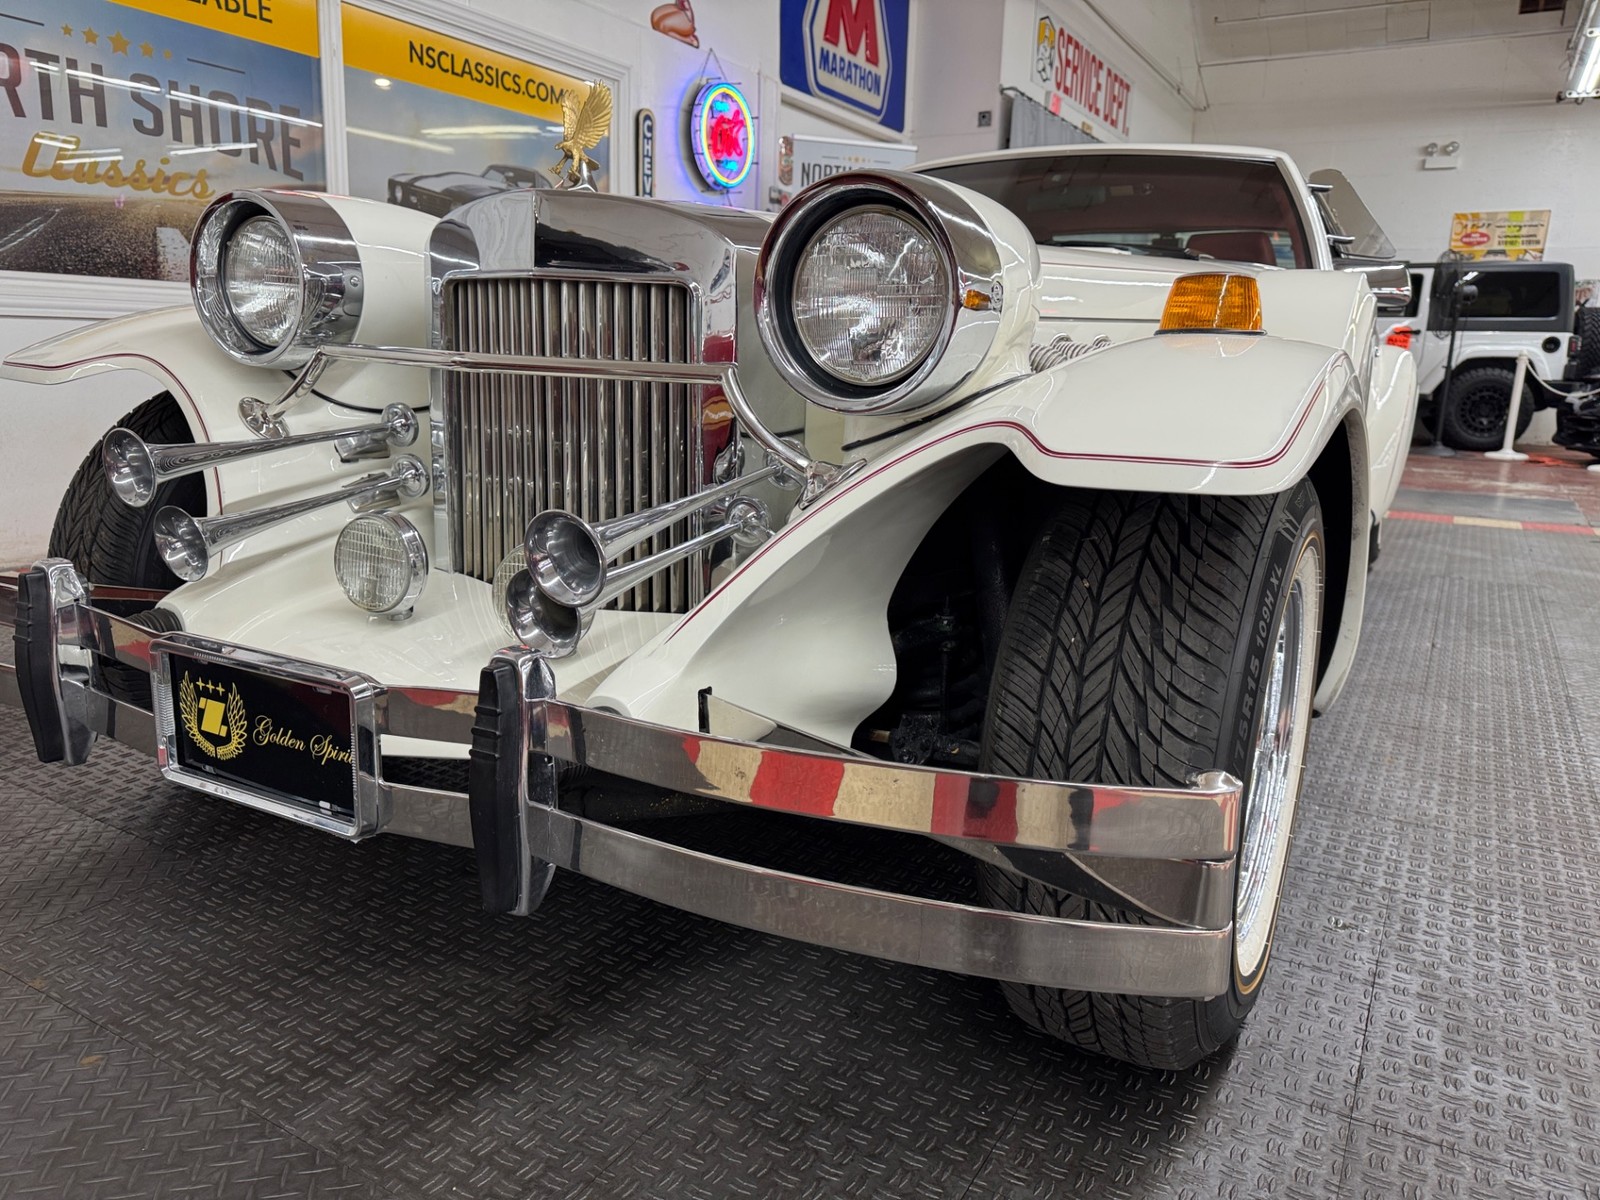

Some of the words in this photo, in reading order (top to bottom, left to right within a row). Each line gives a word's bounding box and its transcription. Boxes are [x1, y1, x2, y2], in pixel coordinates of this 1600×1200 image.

[823, 0, 879, 67] M
[408, 40, 565, 106] NSCLASSICS.COM
[819, 46, 881, 97] MARATHON
[1055, 27, 1104, 117] SERVICE
[1103, 67, 1131, 137] DEPT.
[129, 72, 304, 182] SHORE
[643, 119, 653, 199] CHEV
[22, 131, 216, 199] Classics
[801, 162, 852, 187] NOR
[1256, 589, 1276, 647] 109H
[1270, 562, 1283, 588] XL
[252, 715, 308, 751] Golden
